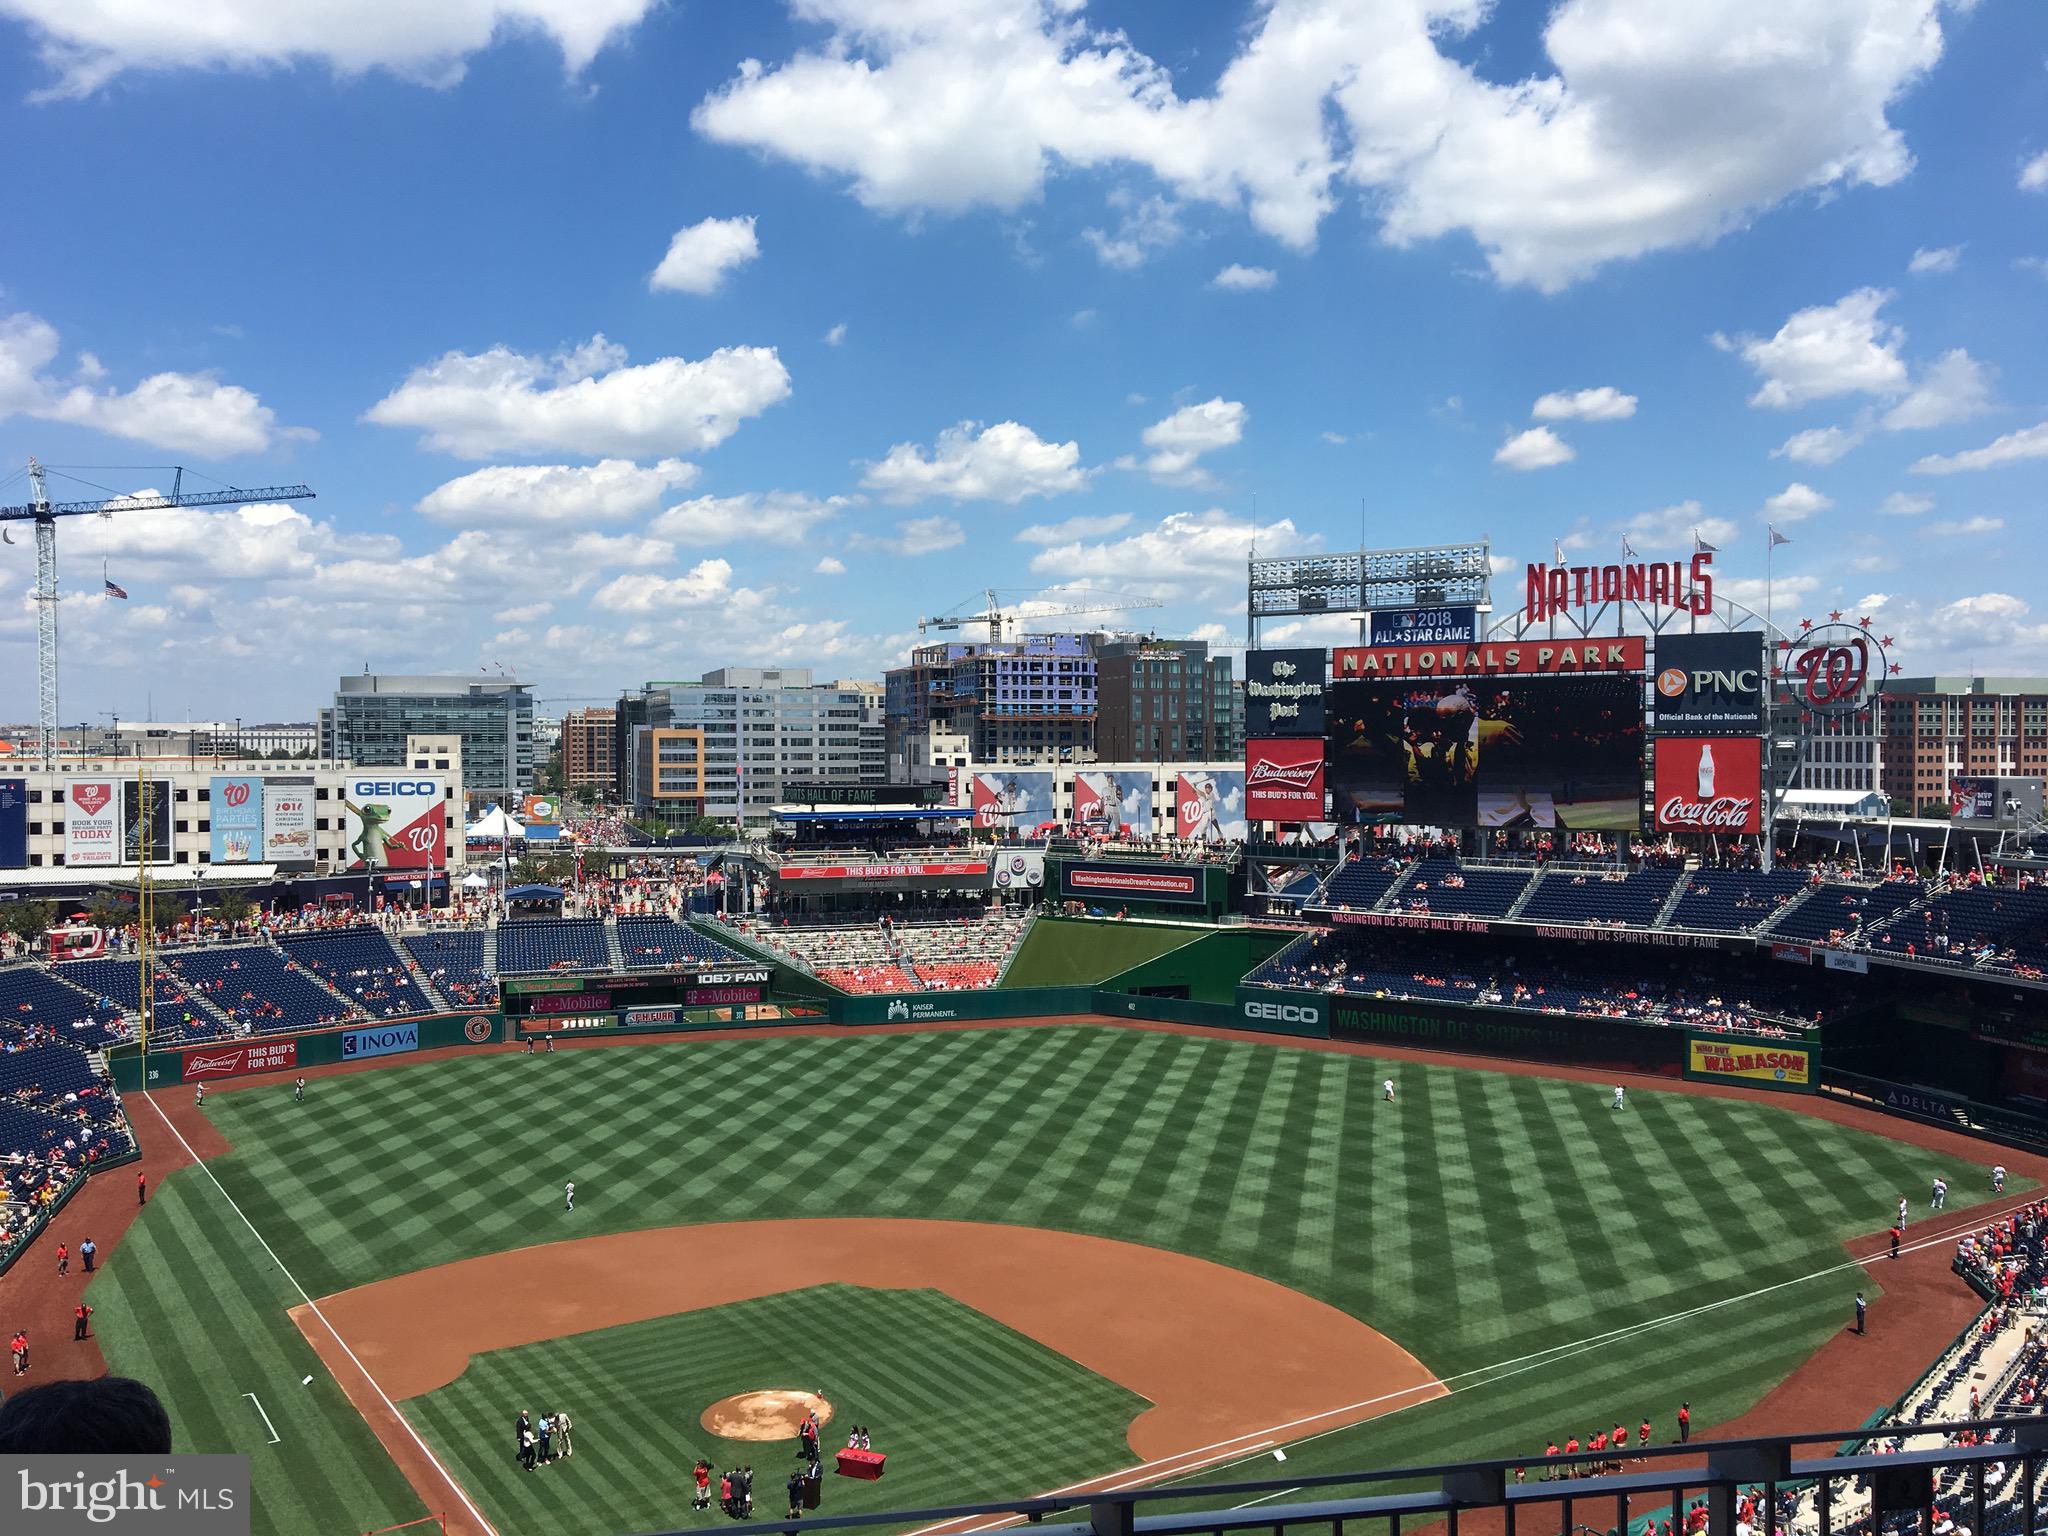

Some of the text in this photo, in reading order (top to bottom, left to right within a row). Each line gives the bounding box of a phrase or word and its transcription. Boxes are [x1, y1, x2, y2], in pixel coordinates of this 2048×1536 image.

[1526, 552, 1713, 623] NATIONALS
[1418, 611, 1452, 626] 2018
[1435, 626, 1471, 640] GAME
[1343, 645, 1625, 671] NATIONALS PARK
[1272, 661, 1297, 678] The
[1691, 669, 1758, 693] PNC
[1248, 679, 1322, 699] Washington
[1270, 702, 1299, 721] Post
[1659, 713, 1684, 721] Official
[1724, 712, 1758, 720] Nationals
[1252, 764, 1315, 778] Budweiser
[355, 781, 436, 796] GEICO
[807, 789, 828, 801] HALL
[831, 789, 844, 801] OF
[848, 789, 876, 802] FAME
[1251, 790, 1318, 800] THIS BUD'S FOR YOU.
[216, 814, 257, 823] PARTIES
[72, 830, 112, 839] TODAY
[845, 867, 863, 876] THIS
[864, 867, 890, 875] BUD'S
[891, 866, 907, 875] FOR
[908, 866, 926, 874] YOU.
[1075, 875, 1189, 889] WashingtonNationalsDreamFoundation.org
[1331, 913, 1489, 933] WASHINGTON DC SPORTS HALL OF FAME
[1535, 926, 1720, 949] WASHINGTON DC SPORTS HALL OF FAME
[735, 972, 768, 982] FAN
[912, 1003, 934, 1011] KAISER
[912, 1009, 955, 1018] PERMANENTE
[1244, 1001, 1319, 1024] GEICO
[1337, 1009, 1440, 1036] WASHINGTON
[362, 1030, 417, 1051] INOVA
[247, 1043, 295, 1058] THIS BUD'S
[1695, 1044, 1730, 1054] WHO BUT
[191, 1057, 237, 1071] Budweiser
[247, 1056, 287, 1069] FOR YOU.
[1901, 1095, 1947, 1115] DELTA
